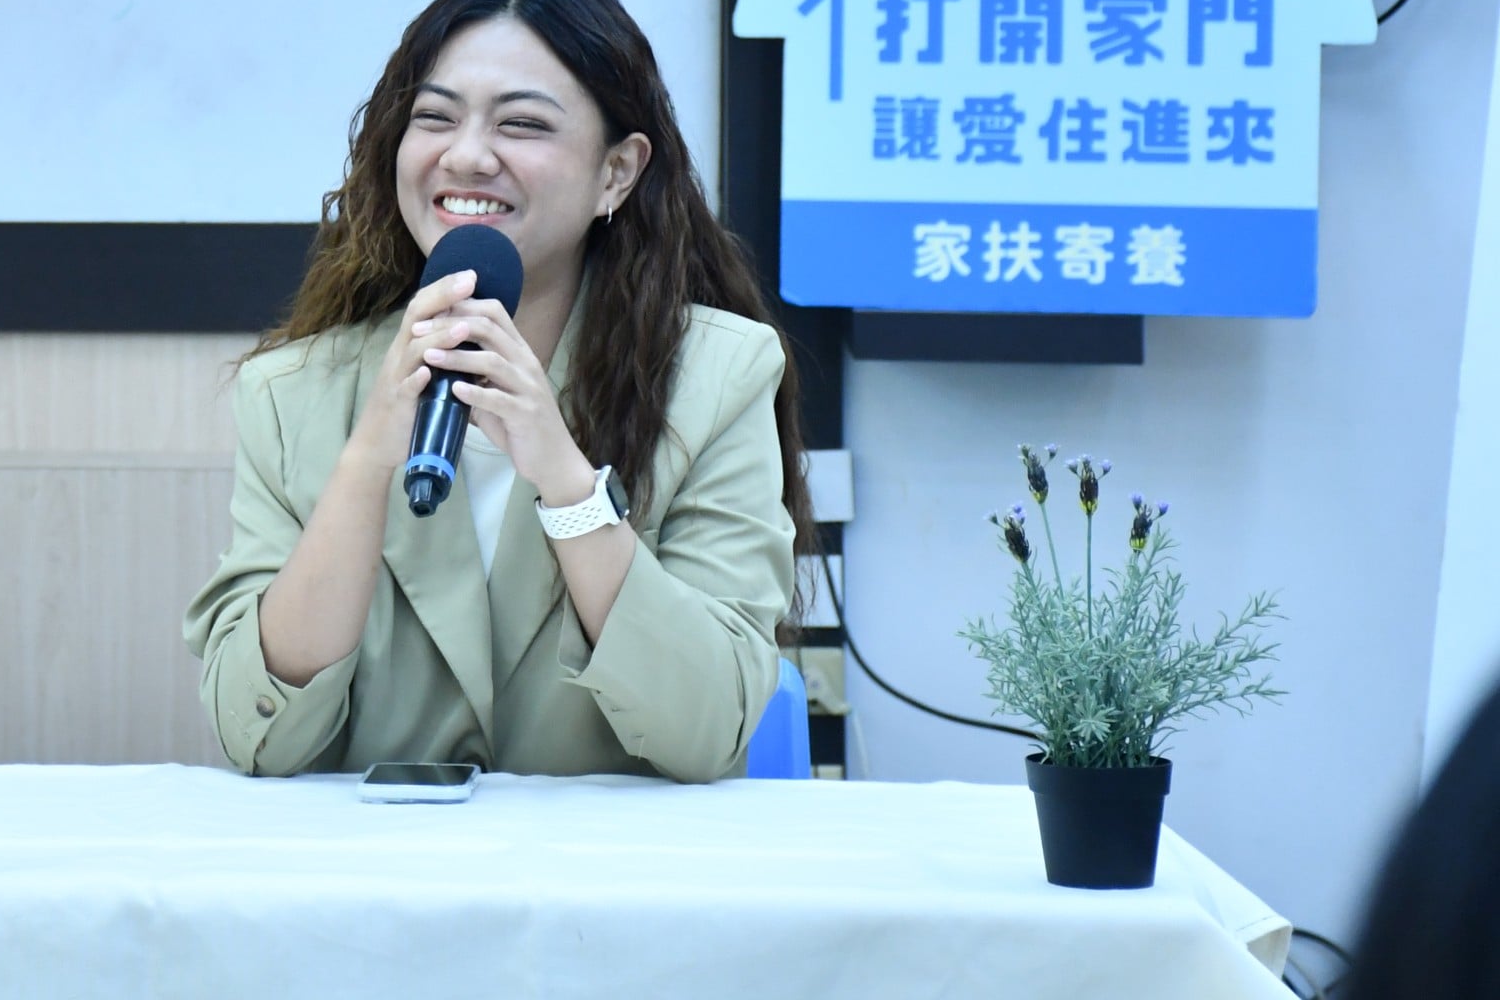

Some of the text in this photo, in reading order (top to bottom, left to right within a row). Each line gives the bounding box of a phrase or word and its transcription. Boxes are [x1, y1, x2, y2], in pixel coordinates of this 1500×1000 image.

[872, 92, 1276, 165] 讓愛住進來
[913, 220, 1188, 287] 家扶寄養
